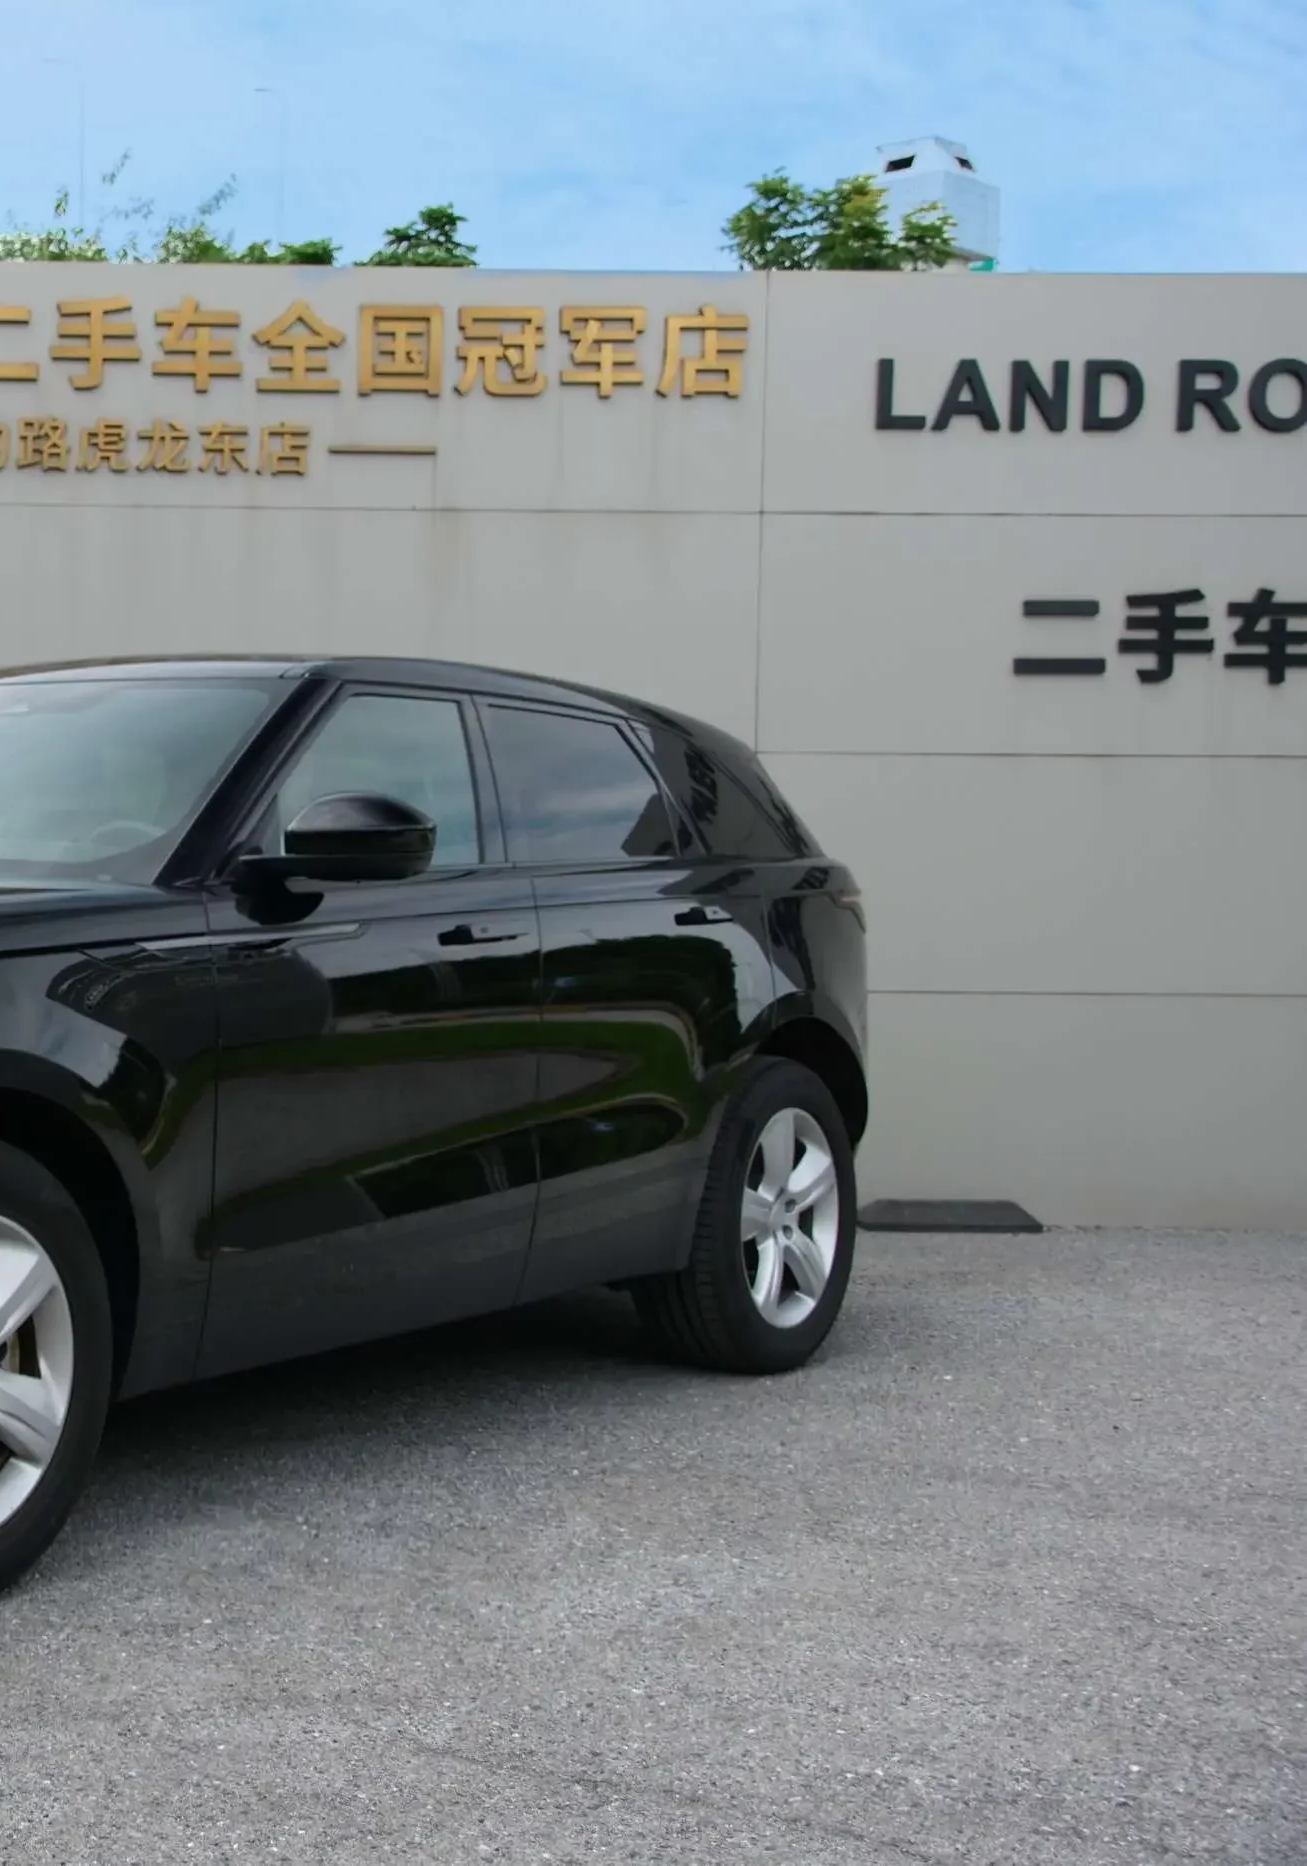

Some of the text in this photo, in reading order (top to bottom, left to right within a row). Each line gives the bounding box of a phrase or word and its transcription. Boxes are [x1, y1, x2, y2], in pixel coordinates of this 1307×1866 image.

[875, 358, 1307, 433] LAND RO
[1012, 588, 1307, 685] 二手车
